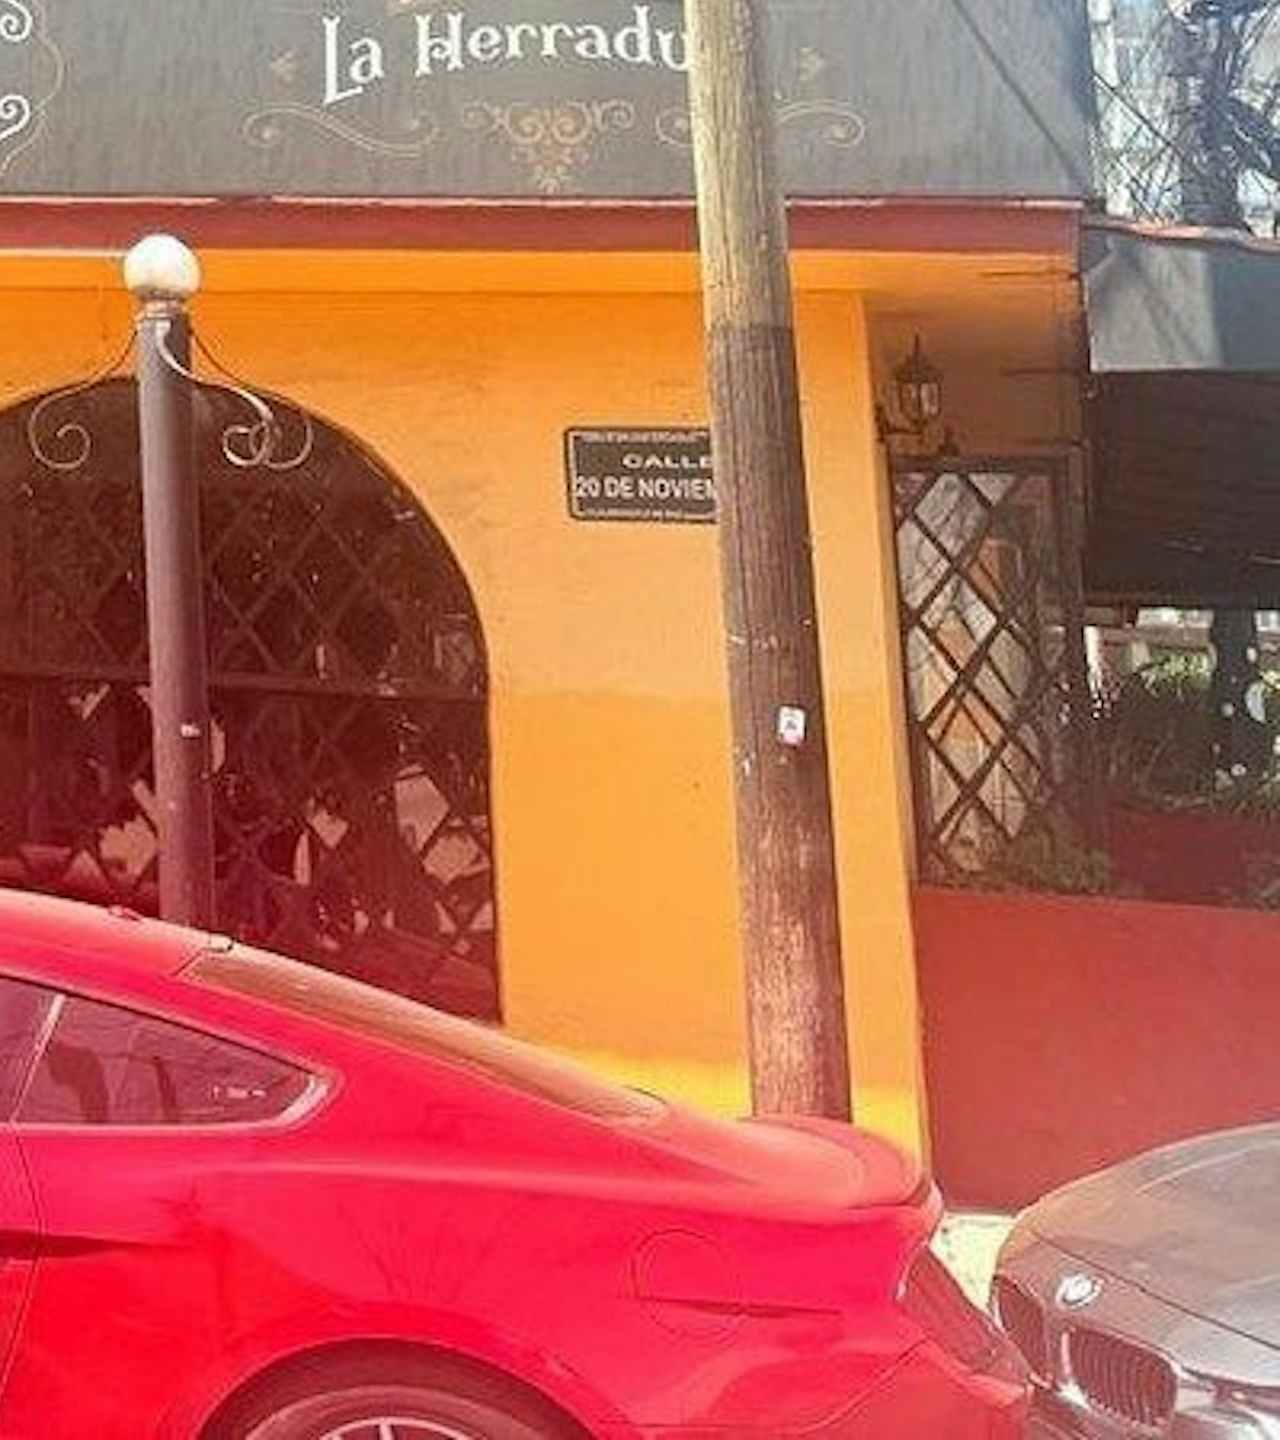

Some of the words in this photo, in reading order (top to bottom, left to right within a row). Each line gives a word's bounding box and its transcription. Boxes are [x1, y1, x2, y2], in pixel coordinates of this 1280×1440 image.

[322, 16, 384, 106] La
[622, 453, 711, 469] CALLE
[575, 475, 601, 498] 20
[603, 475, 635, 501] DE
